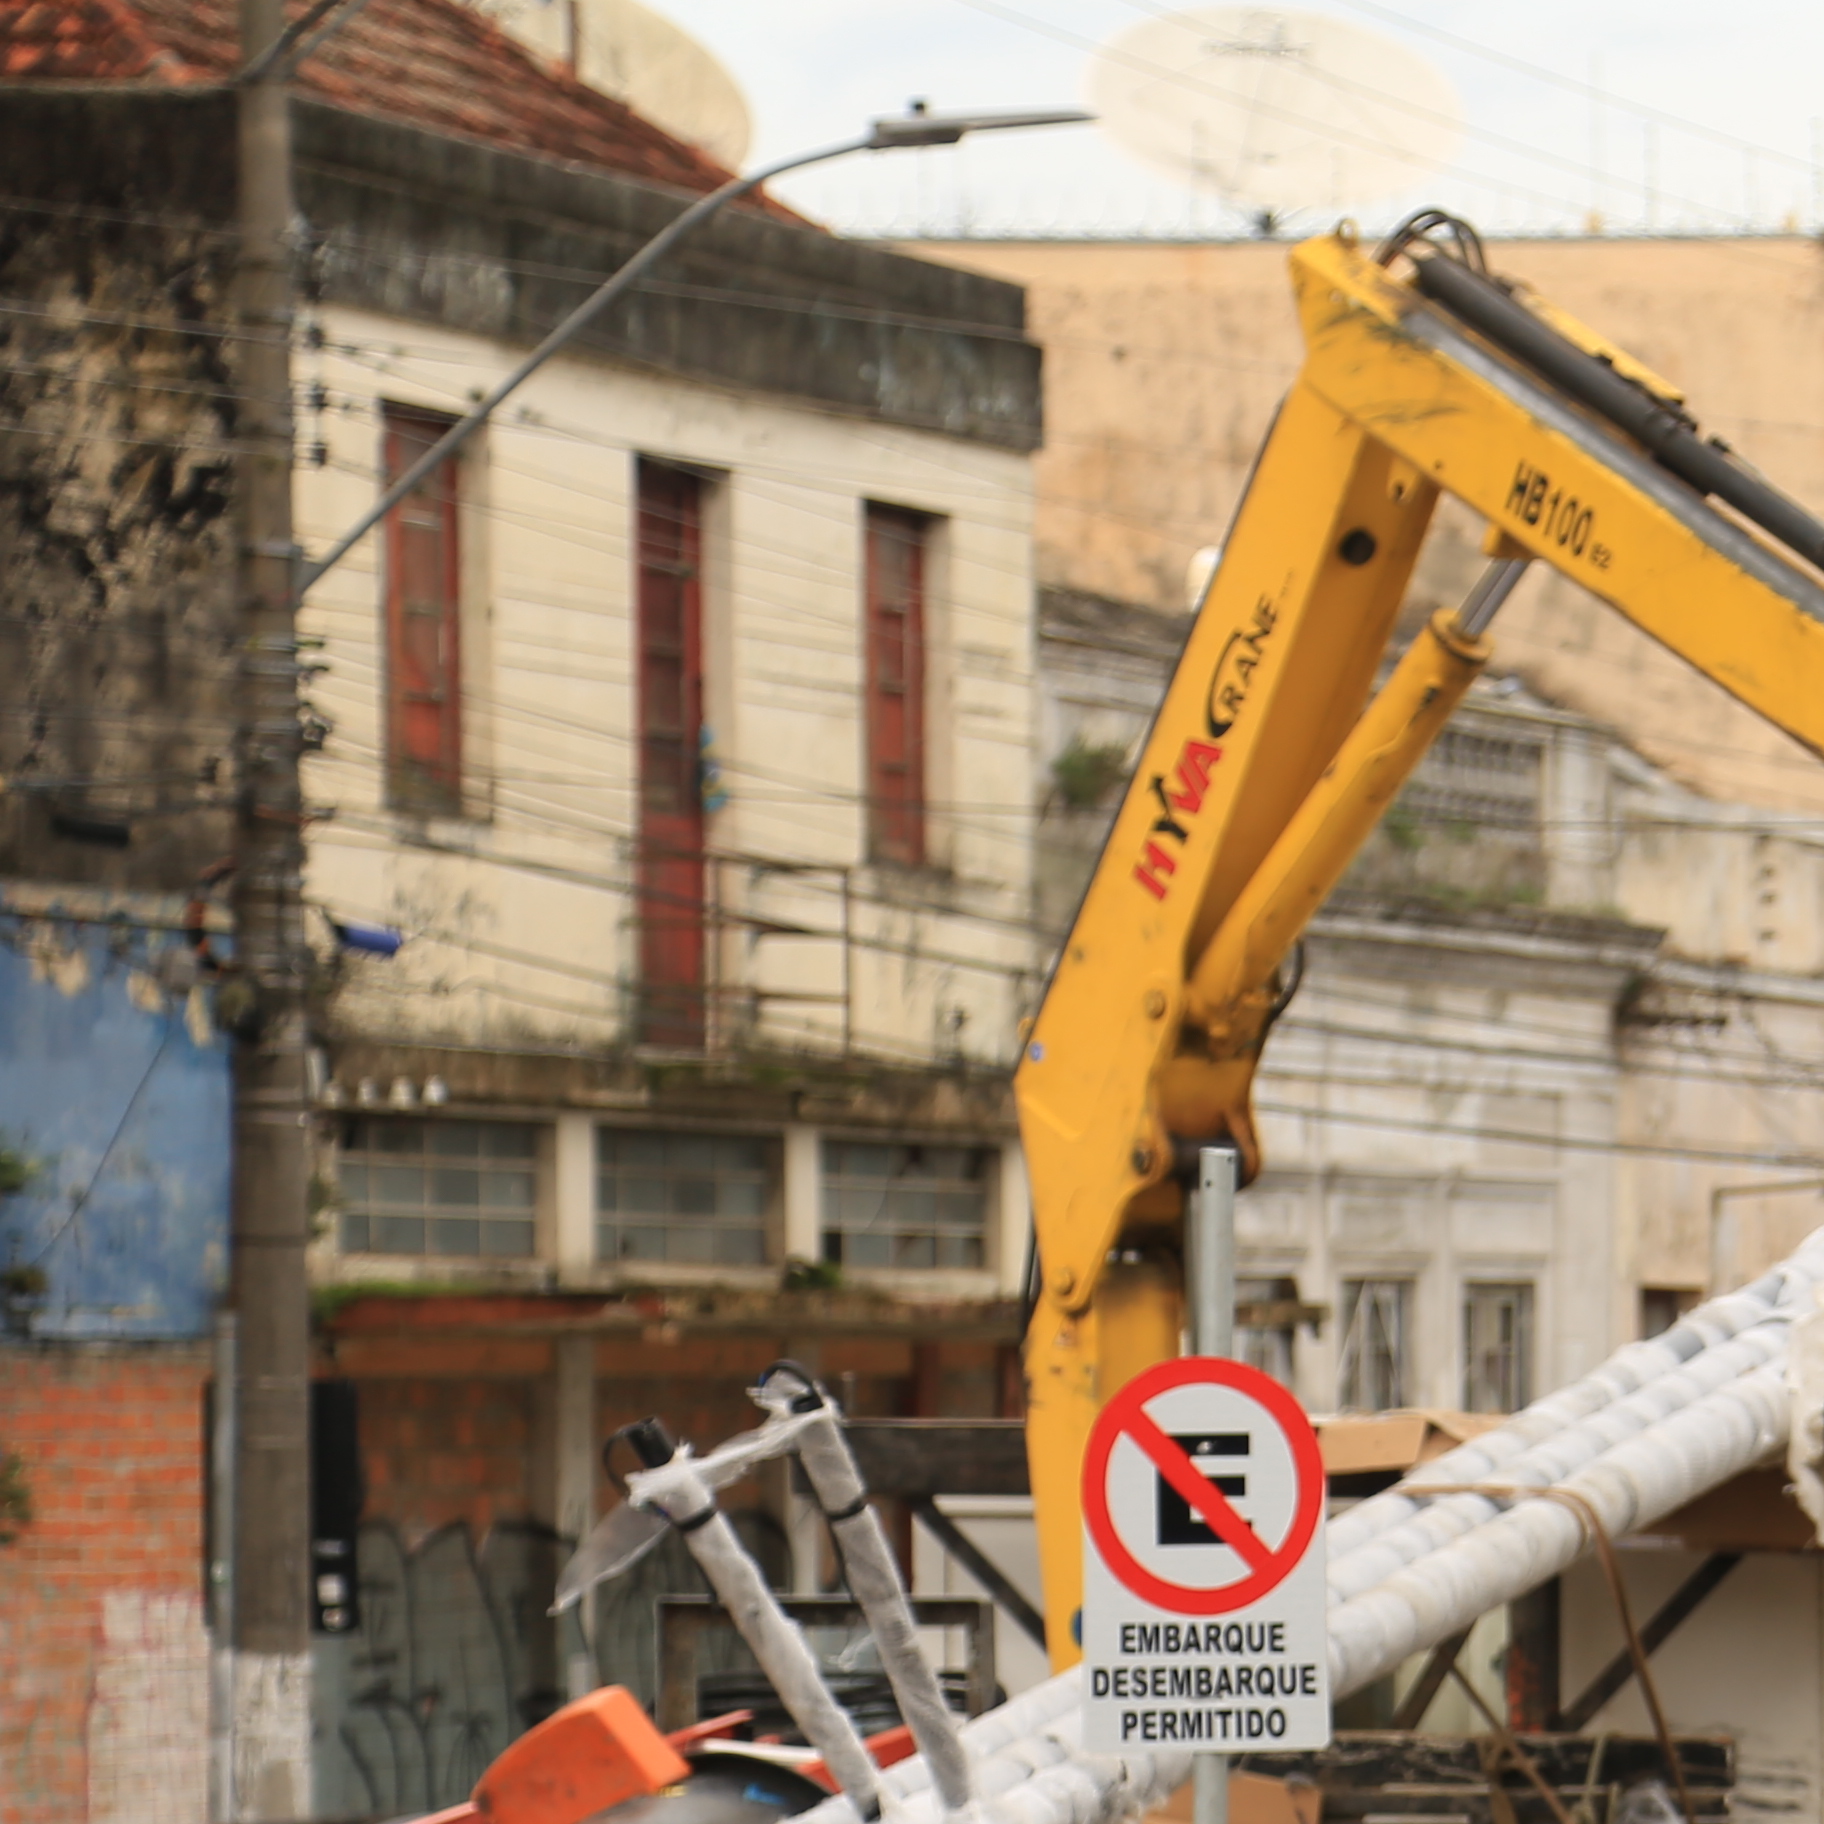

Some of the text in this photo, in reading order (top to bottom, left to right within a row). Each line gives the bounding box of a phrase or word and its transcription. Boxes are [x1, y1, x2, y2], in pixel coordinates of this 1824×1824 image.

[1505, 459, 1594, 556] HB100
[1133, 740, 1223, 902] HYVA
[1119, 1622, 1285, 1654] EMBARQUE
[1092, 1664, 1317, 1698] DESEMBARQUE
[1121, 1708, 1287, 1741] PERMITIDO
